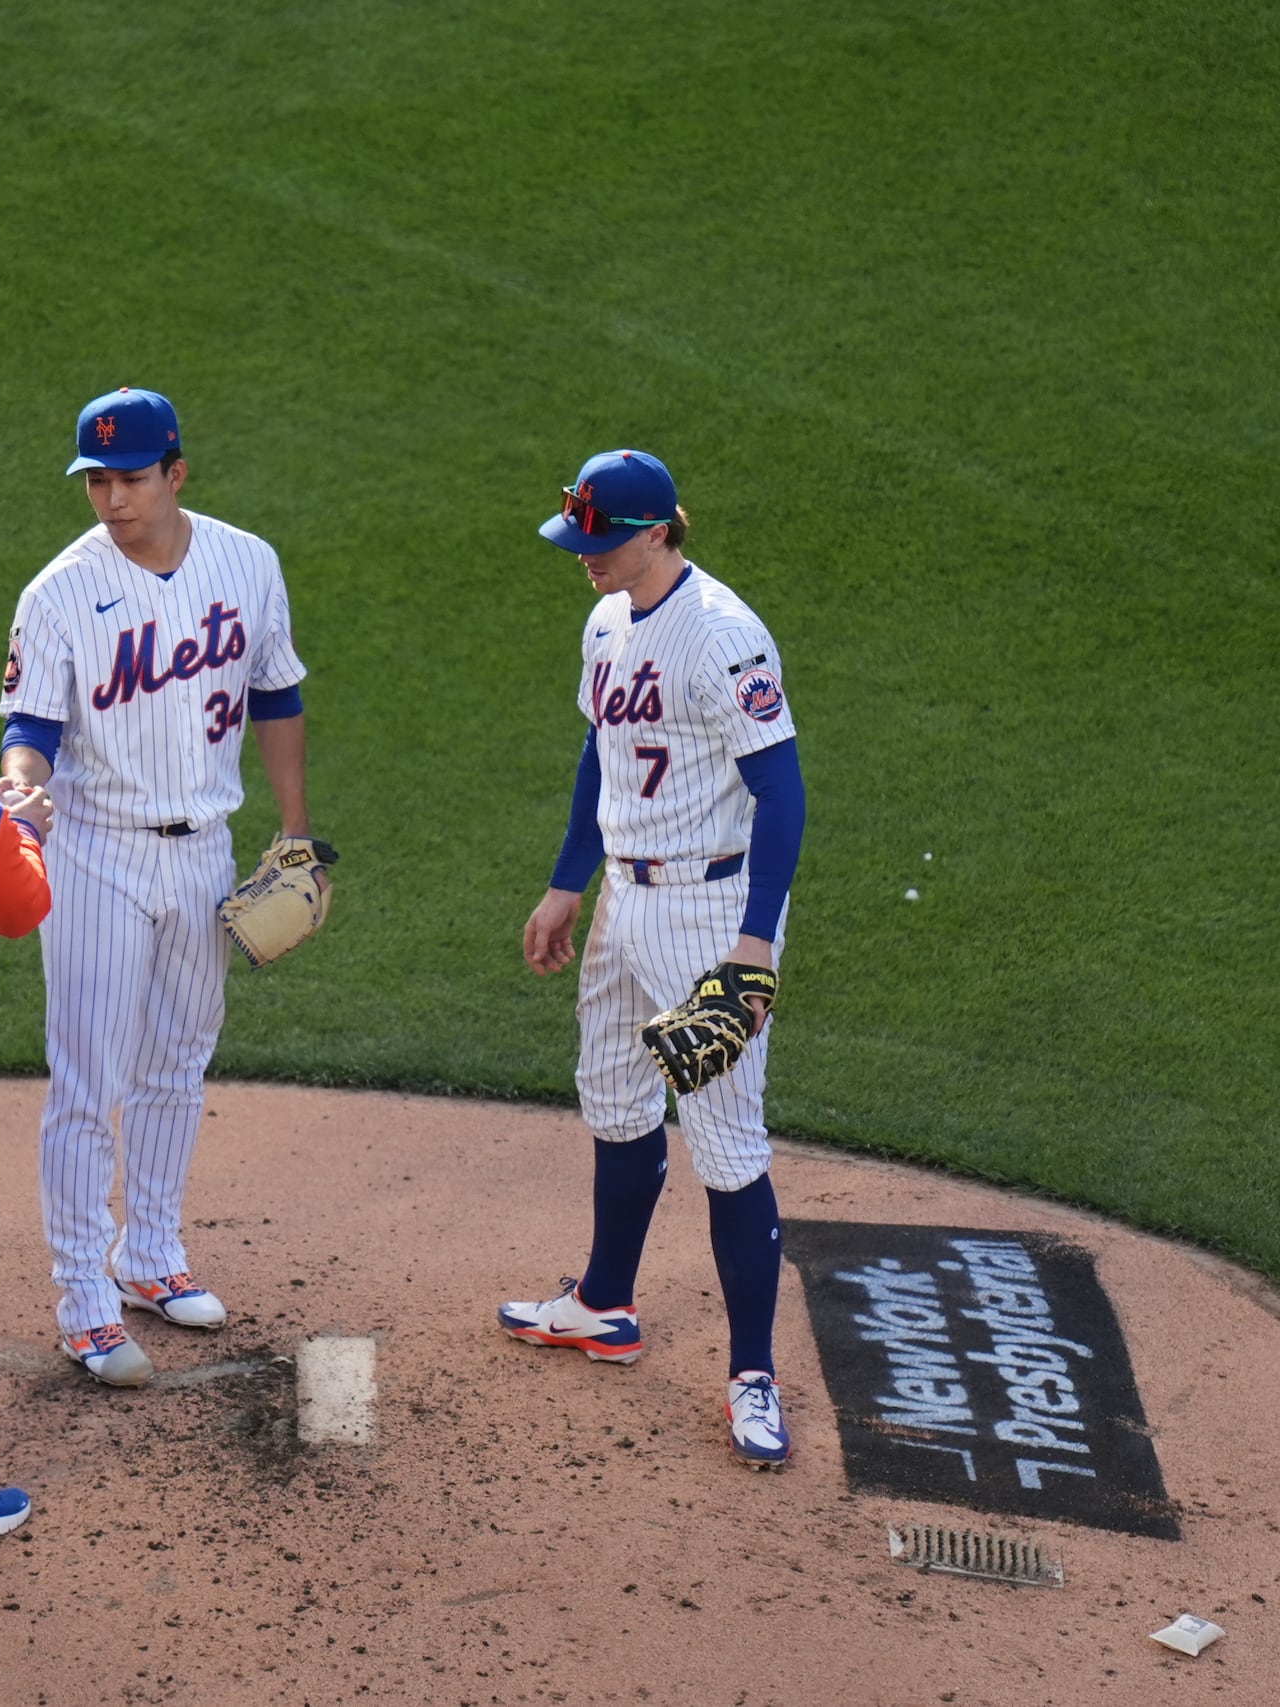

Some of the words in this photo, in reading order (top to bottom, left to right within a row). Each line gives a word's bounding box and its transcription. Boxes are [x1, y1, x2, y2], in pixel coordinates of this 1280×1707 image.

[92, 601, 247, 711] Mets
[204, 682, 248, 744] 34
[634, 746, 670, 798] 7
[742, 972, 775, 989] Wilson
[937, 1239, 1094, 1455] Presbyterian
